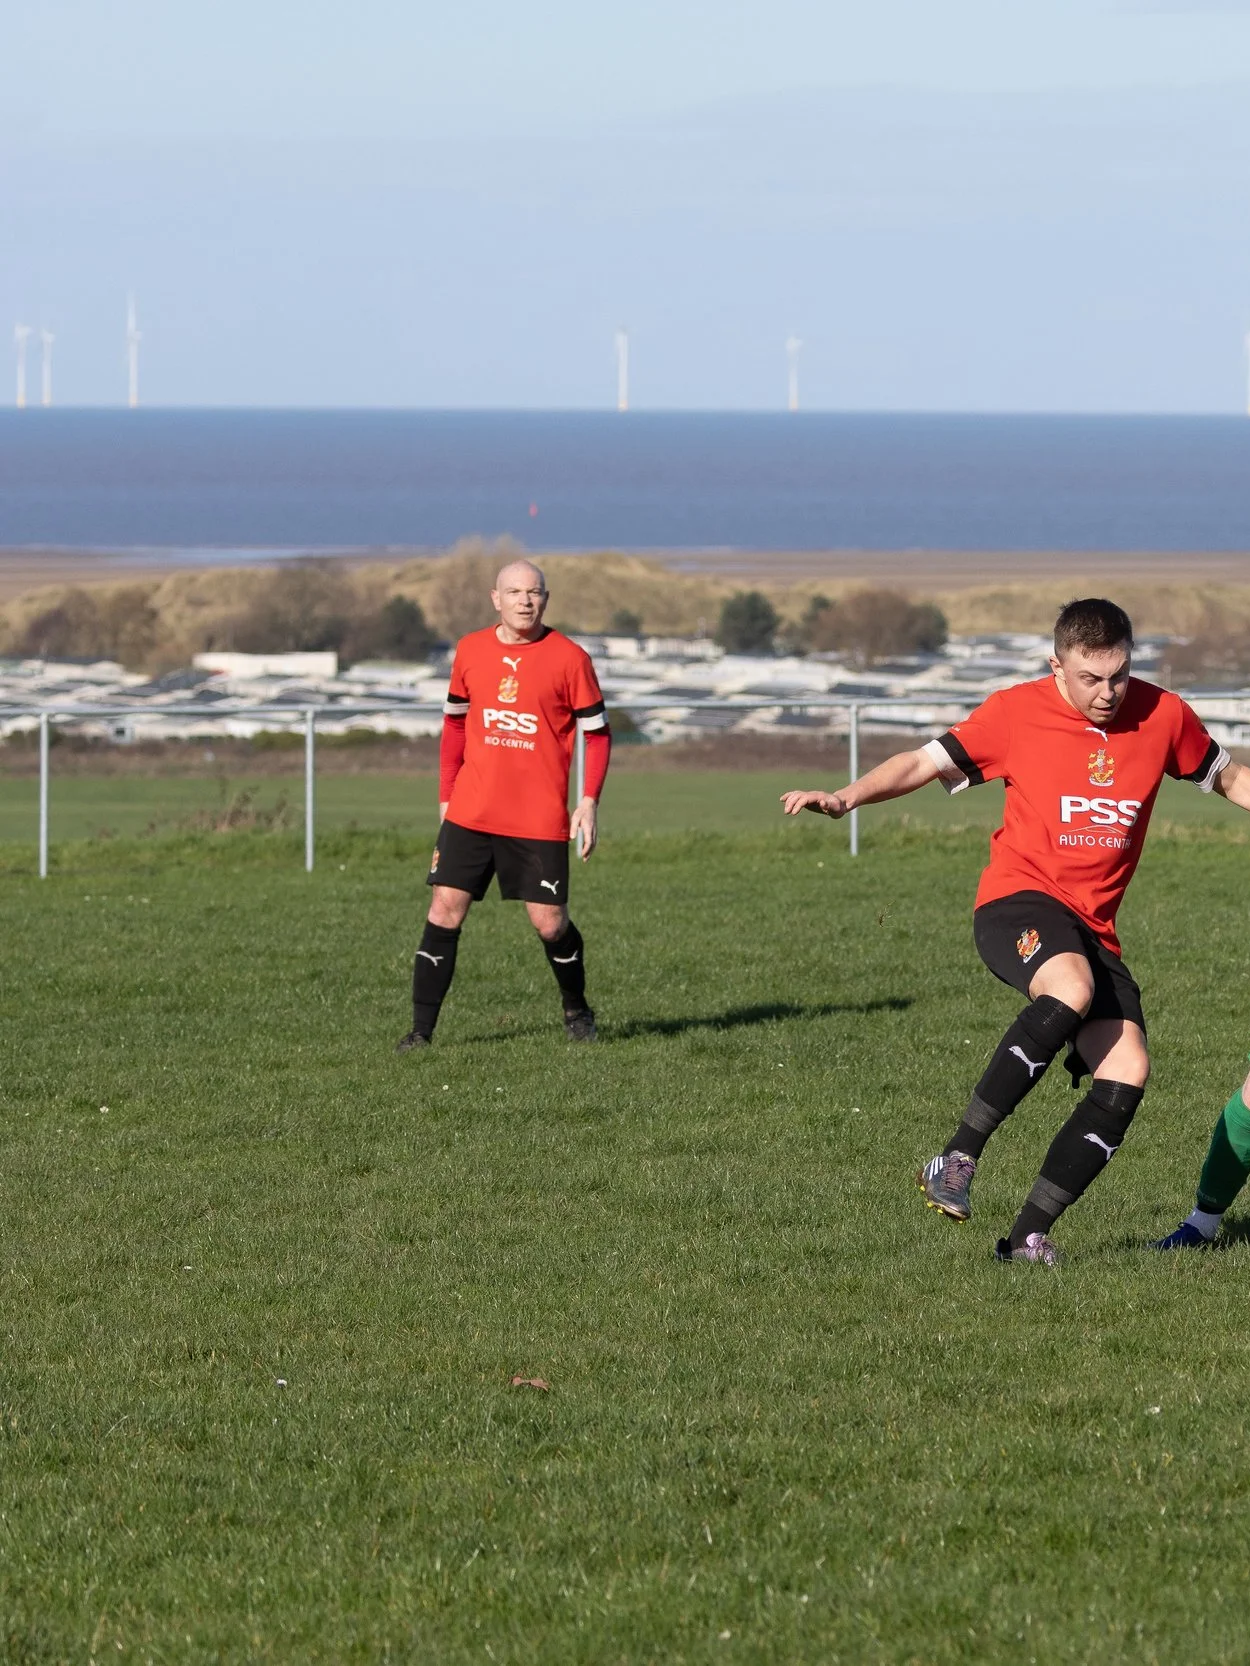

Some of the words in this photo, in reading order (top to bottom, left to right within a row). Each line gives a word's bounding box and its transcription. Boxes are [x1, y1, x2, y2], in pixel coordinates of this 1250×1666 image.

[483, 708, 538, 735] PSS
[501, 738, 535, 751] CENTRE
[1060, 795, 1142, 826] PSS
[1059, 834, 1096, 846] AUTO
